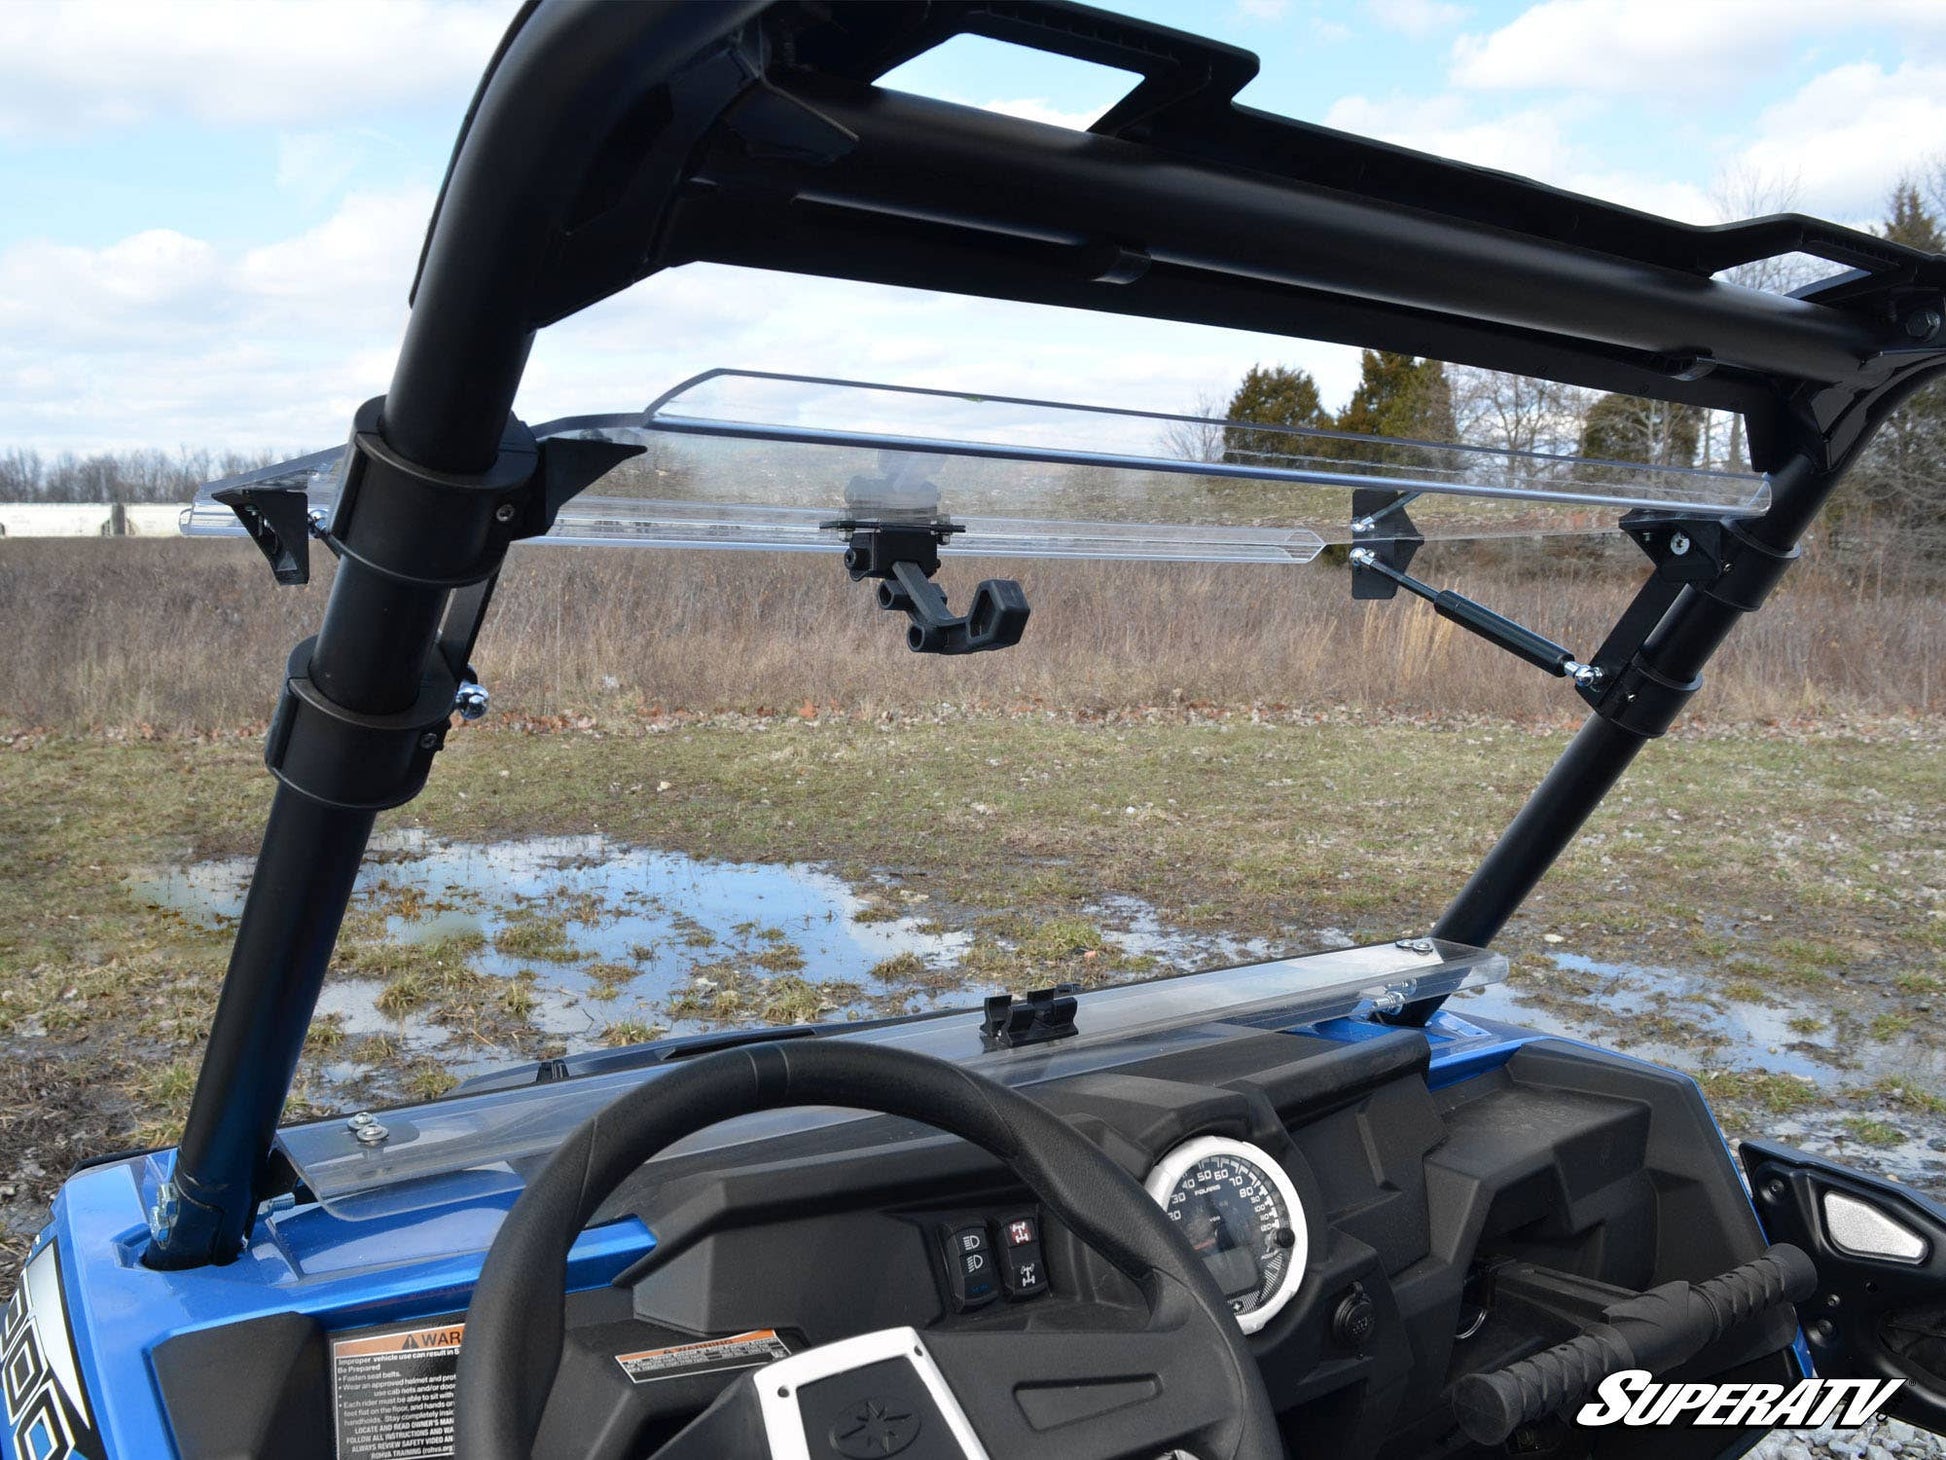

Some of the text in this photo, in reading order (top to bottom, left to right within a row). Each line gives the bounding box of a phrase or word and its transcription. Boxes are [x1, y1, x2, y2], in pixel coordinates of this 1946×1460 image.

[1197, 1170, 1212, 1182] 50
[1214, 1169, 1229, 1181] 60
[1182, 1179, 1195, 1189] 40
[1229, 1176, 1243, 1187] 70
[1194, 1184, 1221, 1196] POLARIS
[1239, 1186, 1254, 1198] 80
[1171, 1192, 1186, 1205] 30
[1254, 1203, 1266, 1213] 100
[338, 1357, 371, 1366] Improper
[373, 1354, 398, 1362] vehicle
[398, 1352, 412, 1360] use
[412, 1351, 426, 1359] can
[426, 1349, 446, 1357] result
[446, 1347, 454, 1355] in
[348, 1363, 381, 1373] Prepared
[367, 1372, 382, 1380] seat
[371, 1378, 404, 1389] approved
[404, 1376, 428, 1385] helmet
[428, 1375, 442, 1383] and
[387, 1387, 401, 1396] cab
[401, 1386, 416, 1394] nets
[416, 1384, 439, 1393] and/or
[343, 1400, 361, 1409] Each
[361, 1399, 377, 1407] rider
[378, 1397, 396, 1405] must
[396, 1395, 406, 1403] be
[406, 1393, 421, 1402] able
[421, 1393, 430, 1401] to
[409, 1402, 423, 1411] and
[424, 1400, 445, 1409] hands
[384, 1415, 401, 1423] Stay
[401, 1410, 439, 1420] completely
[354, 1425, 379, 1434] LOCATE
[379, 1424, 393, 1432] AND
[393, 1421, 410, 1430] READ
[346, 1435, 372, 1444] FOLLOW
[372, 1433, 384, 1441] ALL
[385, 1428, 429, 1440] INSTRUCTIONS
[429, 1427, 443, 1436] AND
[351, 1443, 377, 1452] ALWAYS
[377, 1440, 401, 1450] REVIEW
[401, 1438, 424, 1447] SAFETY
[425, 1436, 443, 1445] VIDEO
[393, 1447, 421, 1457] TRAINING
